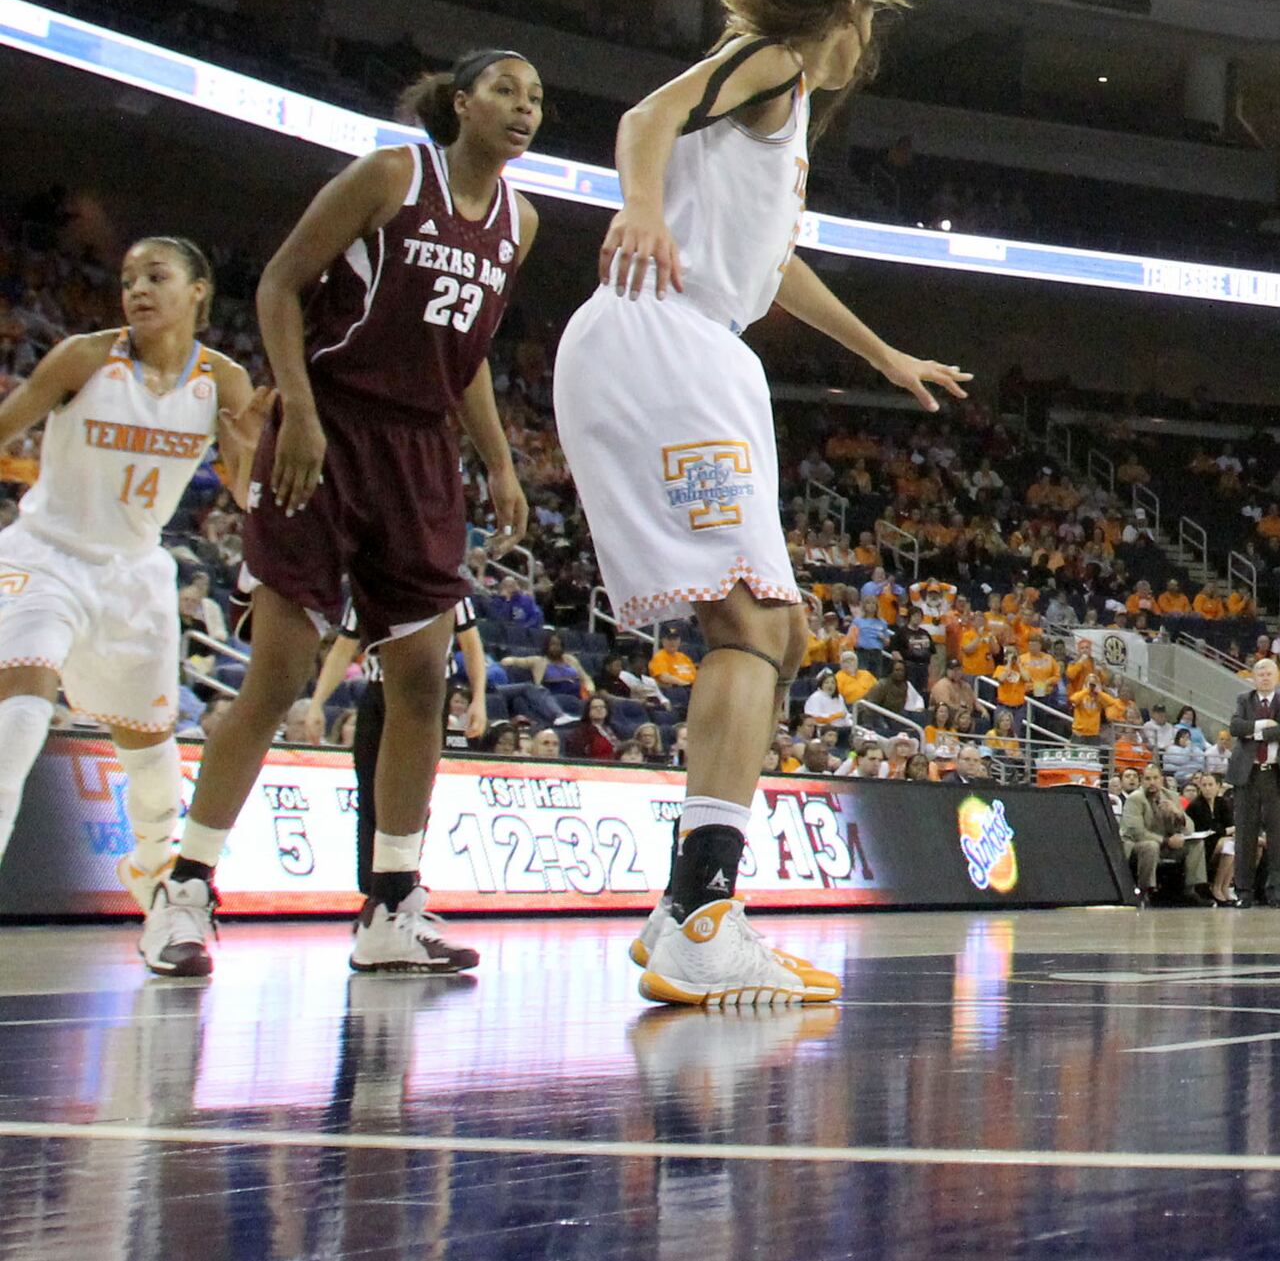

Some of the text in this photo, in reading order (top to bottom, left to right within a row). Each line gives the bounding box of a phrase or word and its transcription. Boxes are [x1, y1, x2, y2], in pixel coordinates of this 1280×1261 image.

[403, 238, 476, 279] TEXAS
[423, 275, 484, 333] 23
[83, 418, 208, 460] TENNESSE
[119, 463, 160, 509] 14
[666, 483, 754, 507] Volunteers
[686, 460, 730, 486] Lady
[263, 784, 310, 811] TOL
[478, 776, 582, 810] 1ST Half
[274, 816, 315, 876] 5
[448, 813, 650, 895] 12:32
[768, 793, 852, 879] 13
[960, 798, 1015, 890] Sunkist
